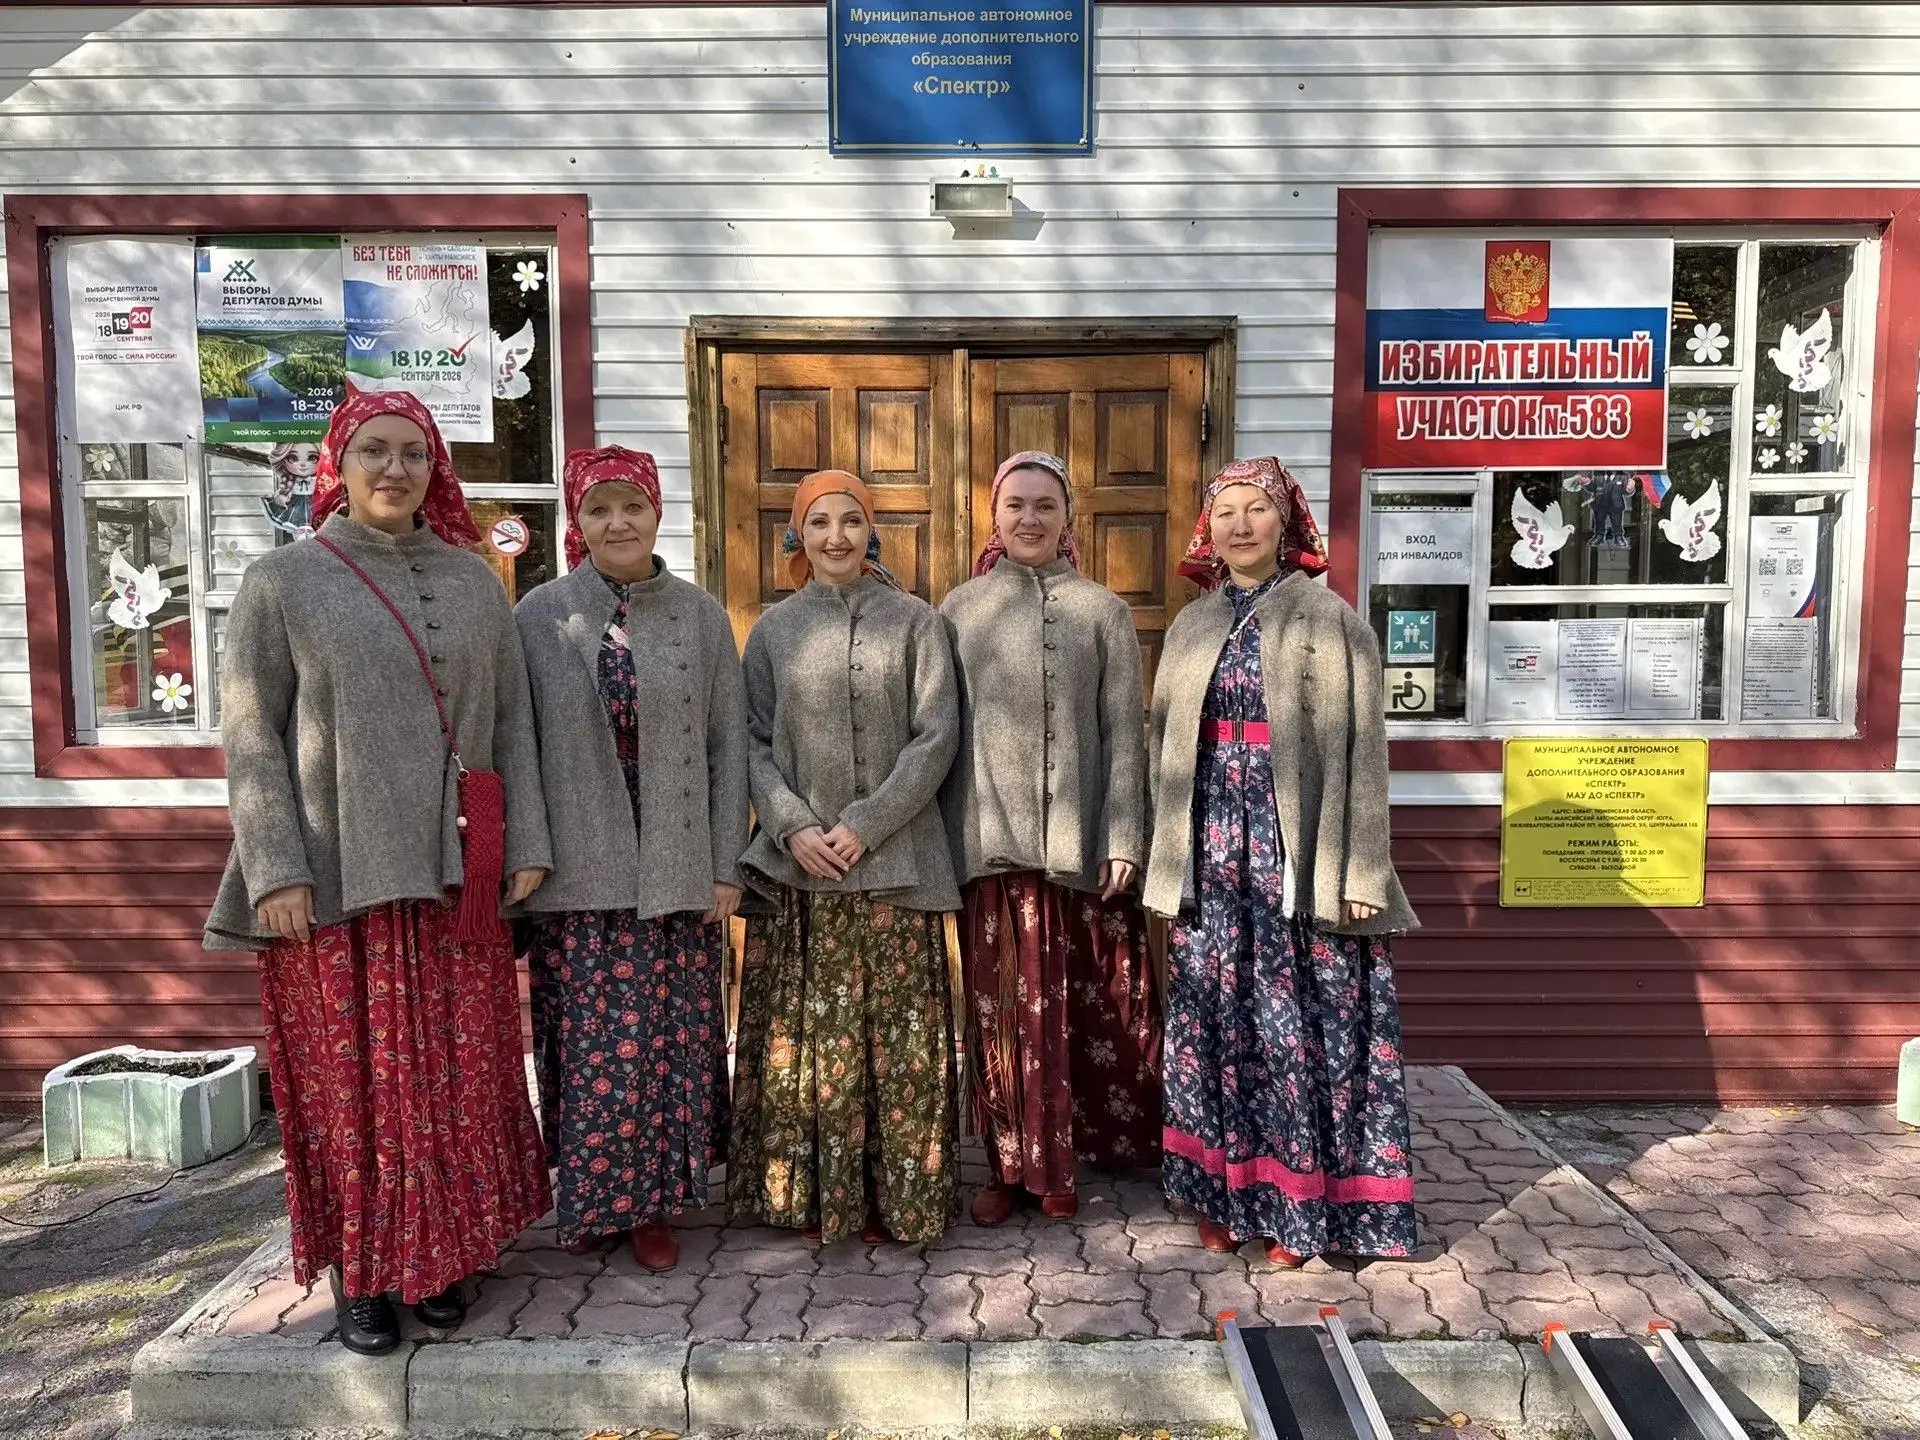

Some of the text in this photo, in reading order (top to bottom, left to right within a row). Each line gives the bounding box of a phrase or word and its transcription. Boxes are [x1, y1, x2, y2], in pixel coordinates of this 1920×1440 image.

[850, 8, 1072, 24] Муниципальное автономное
[844, 31, 1079, 46] учреждение дополнительного
[912, 52, 1012, 68] образования
[913, 75, 1010, 98] «Спектр»
[354, 246, 411, 262] БЕЗ ТЕБЯ
[387, 265, 478, 281] НЕ СЛОЖИТСЯ!
[222, 286, 271, 295] ВЫБОРЫ
[222, 297, 323, 306] ДЕПУТАТОВ ДУМЫ
[131, 311, 149, 324] 20
[114, 318, 128, 330] 19
[98, 325, 112, 337] 18
[1380, 332, 1652, 384] ИЗБИРАТЕЛЬНЫЙ
[401, 371, 462, 381] СЕНТЯБРЯ 2026
[308, 388, 334, 396] 2026
[1398, 396, 1542, 440] УЧАСТОК
[1406, 535, 1436, 546] ВХОД
[1378, 551, 1463, 561] ДЛЯ ИНВАЛИДОВ
[1534, 746, 1615, 754] МУНИЦИПАЛЬНОЕ
[1527, 768, 1618, 777] ДОПОЛНИТЕЛЬНОГО
[1588, 792, 1603, 800] ДО
